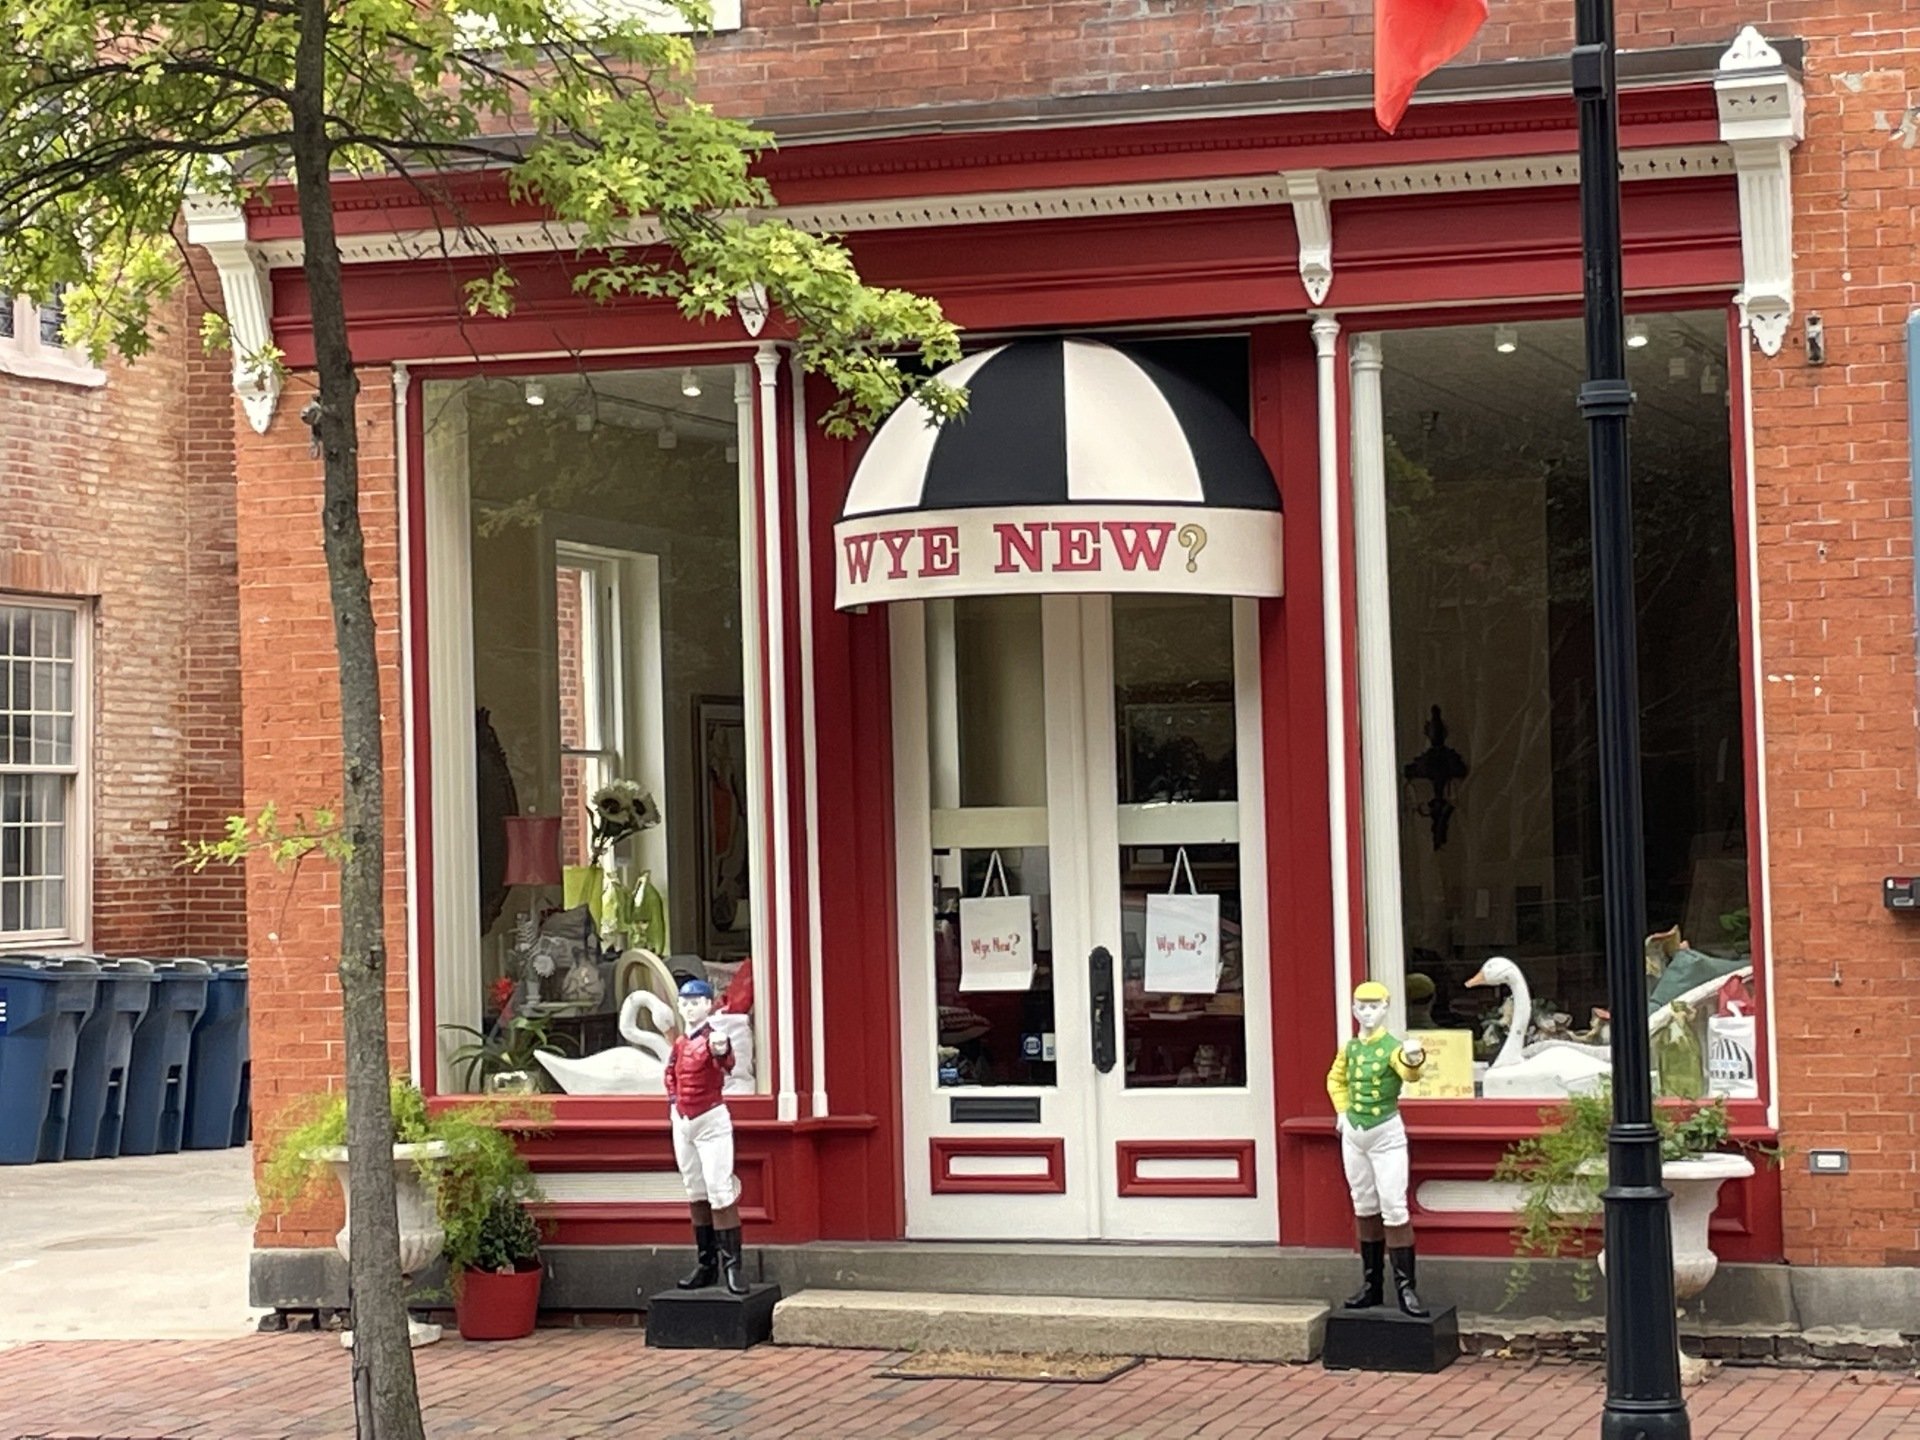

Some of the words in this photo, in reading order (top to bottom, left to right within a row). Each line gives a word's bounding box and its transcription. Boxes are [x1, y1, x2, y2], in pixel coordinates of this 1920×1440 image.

[844, 526, 959, 584] WYE
[993, 522, 1208, 573] NEW?
[970, 938, 991, 960] Wye
